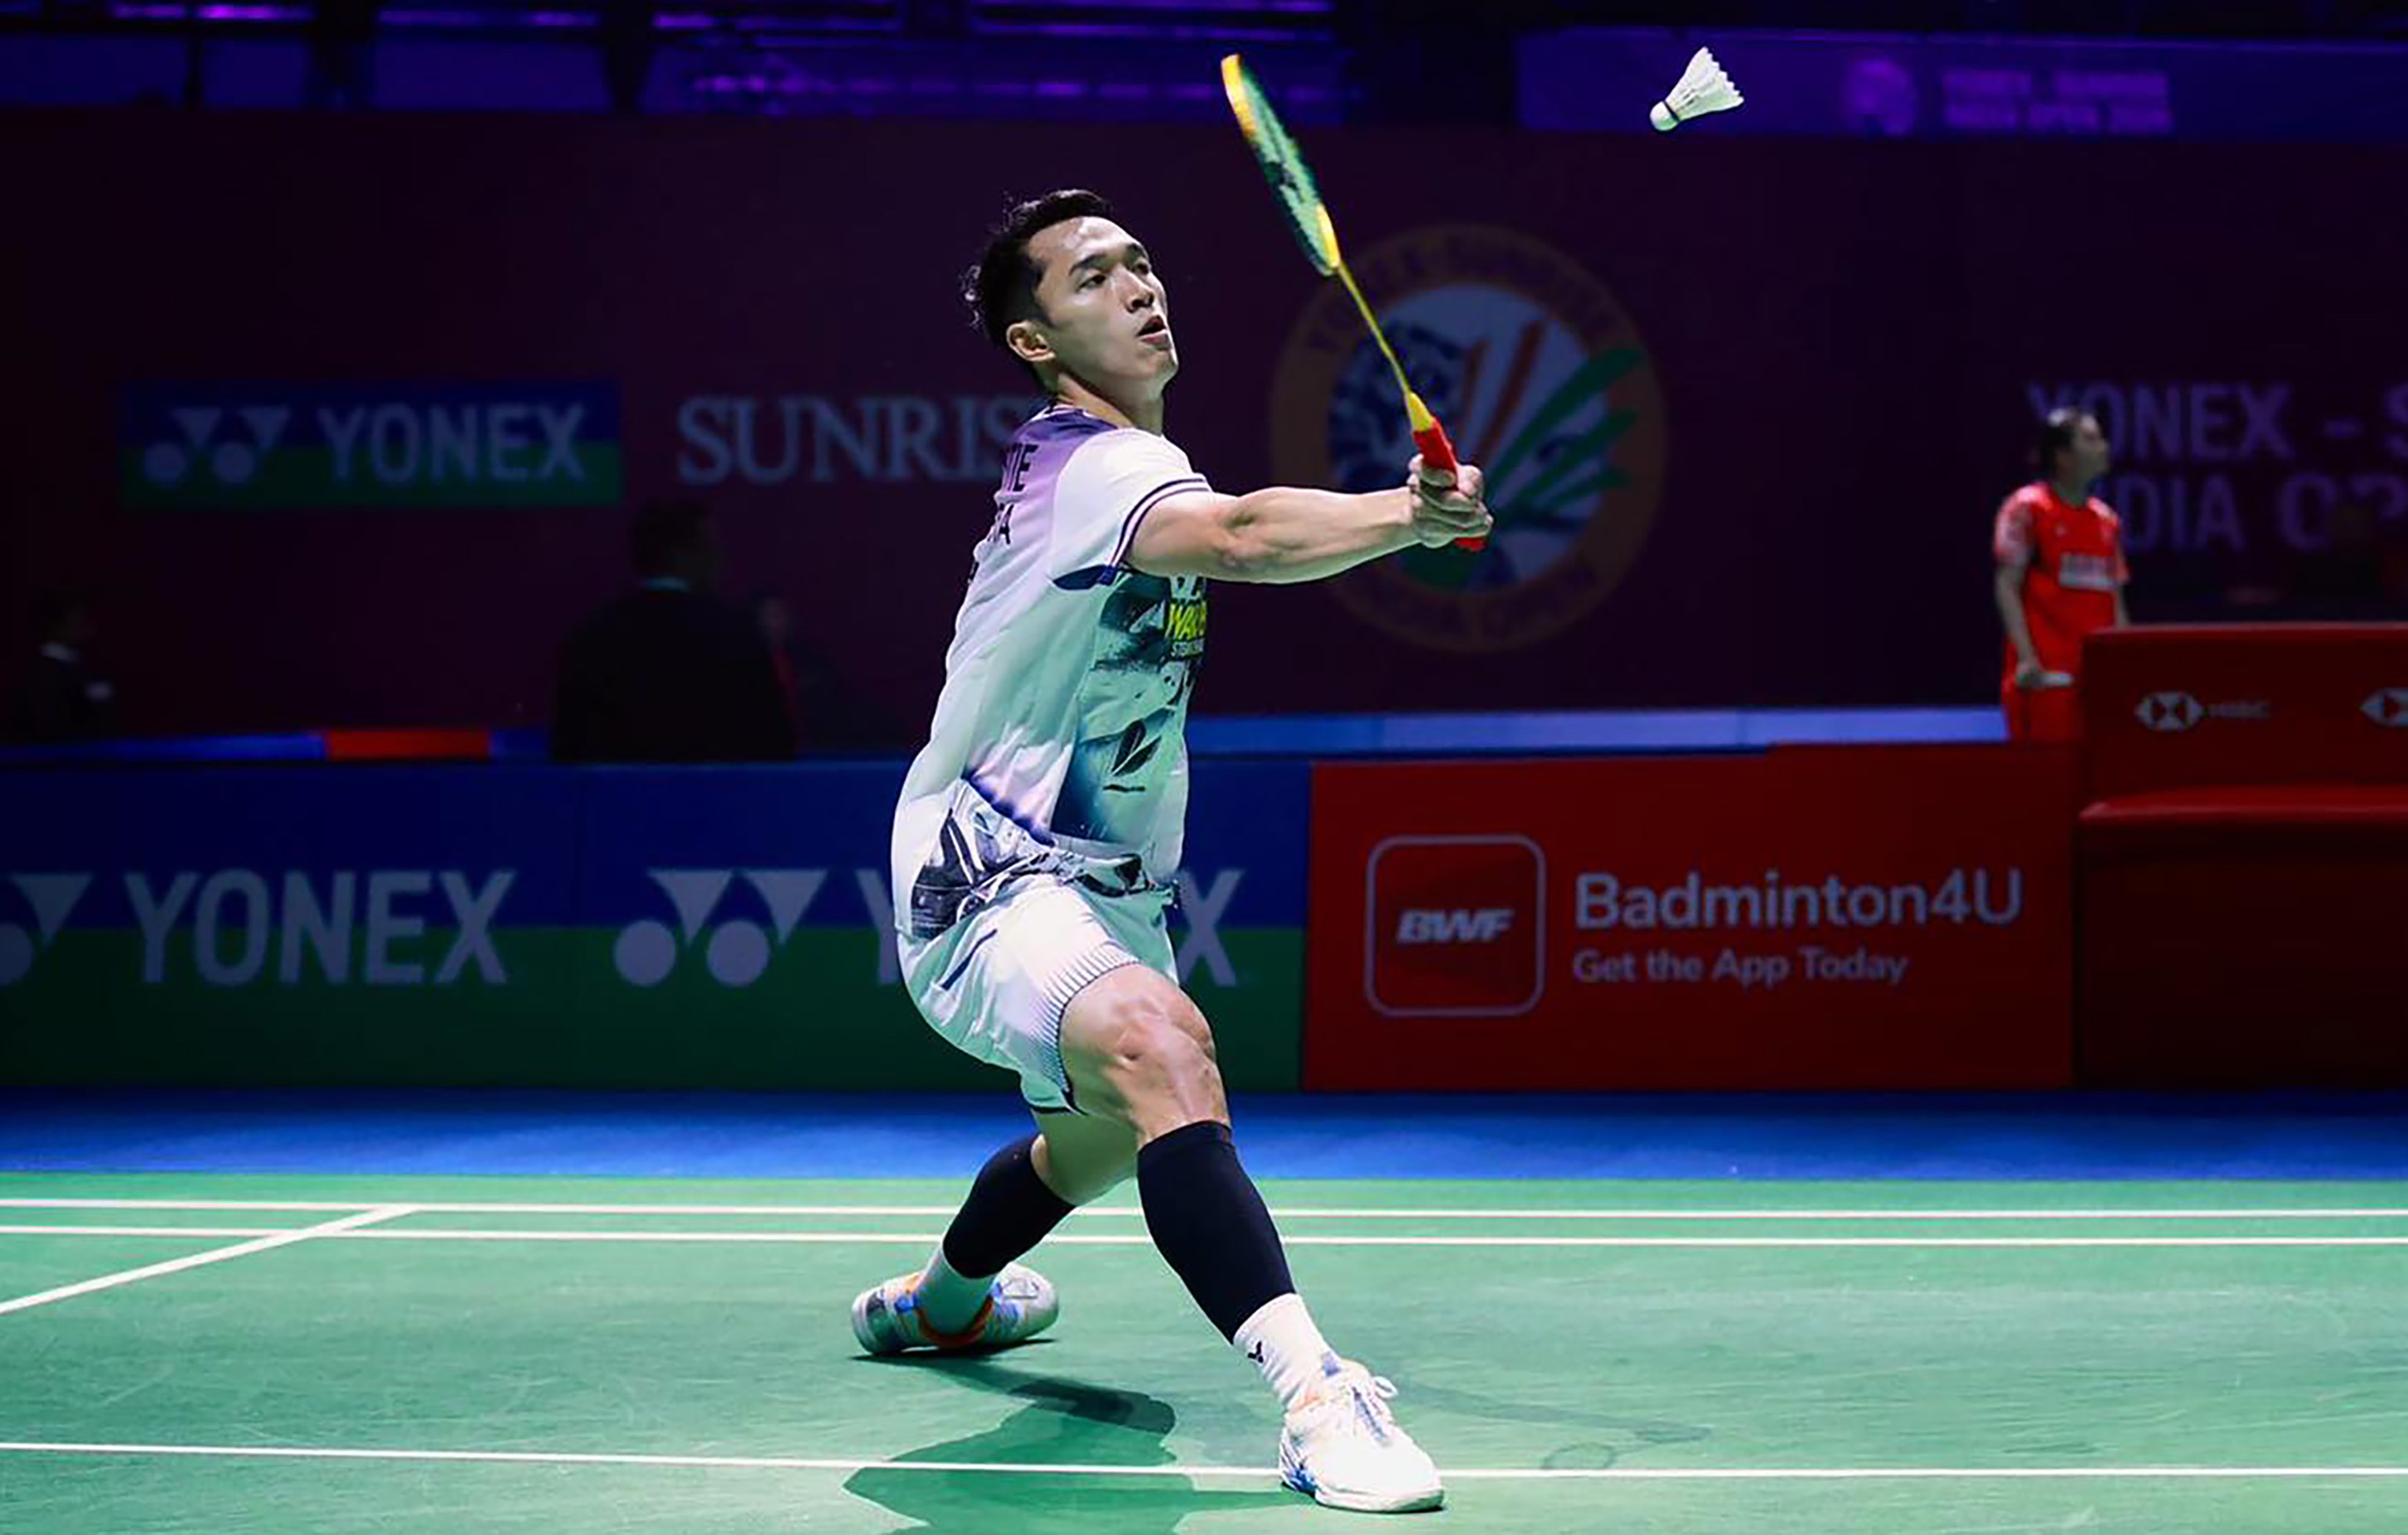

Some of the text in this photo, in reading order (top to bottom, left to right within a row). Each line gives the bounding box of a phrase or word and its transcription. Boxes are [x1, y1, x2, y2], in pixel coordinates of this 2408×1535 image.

[317, 402, 585, 482] YONEX
[676, 394, 1026, 485] SUNRIS
[124, 868, 516, 986] YONEX
[1397, 908, 1514, 944] BWF
[1575, 868, 2022, 929] Badminton4U
[1573, 944, 1909, 988] Get the App Today
